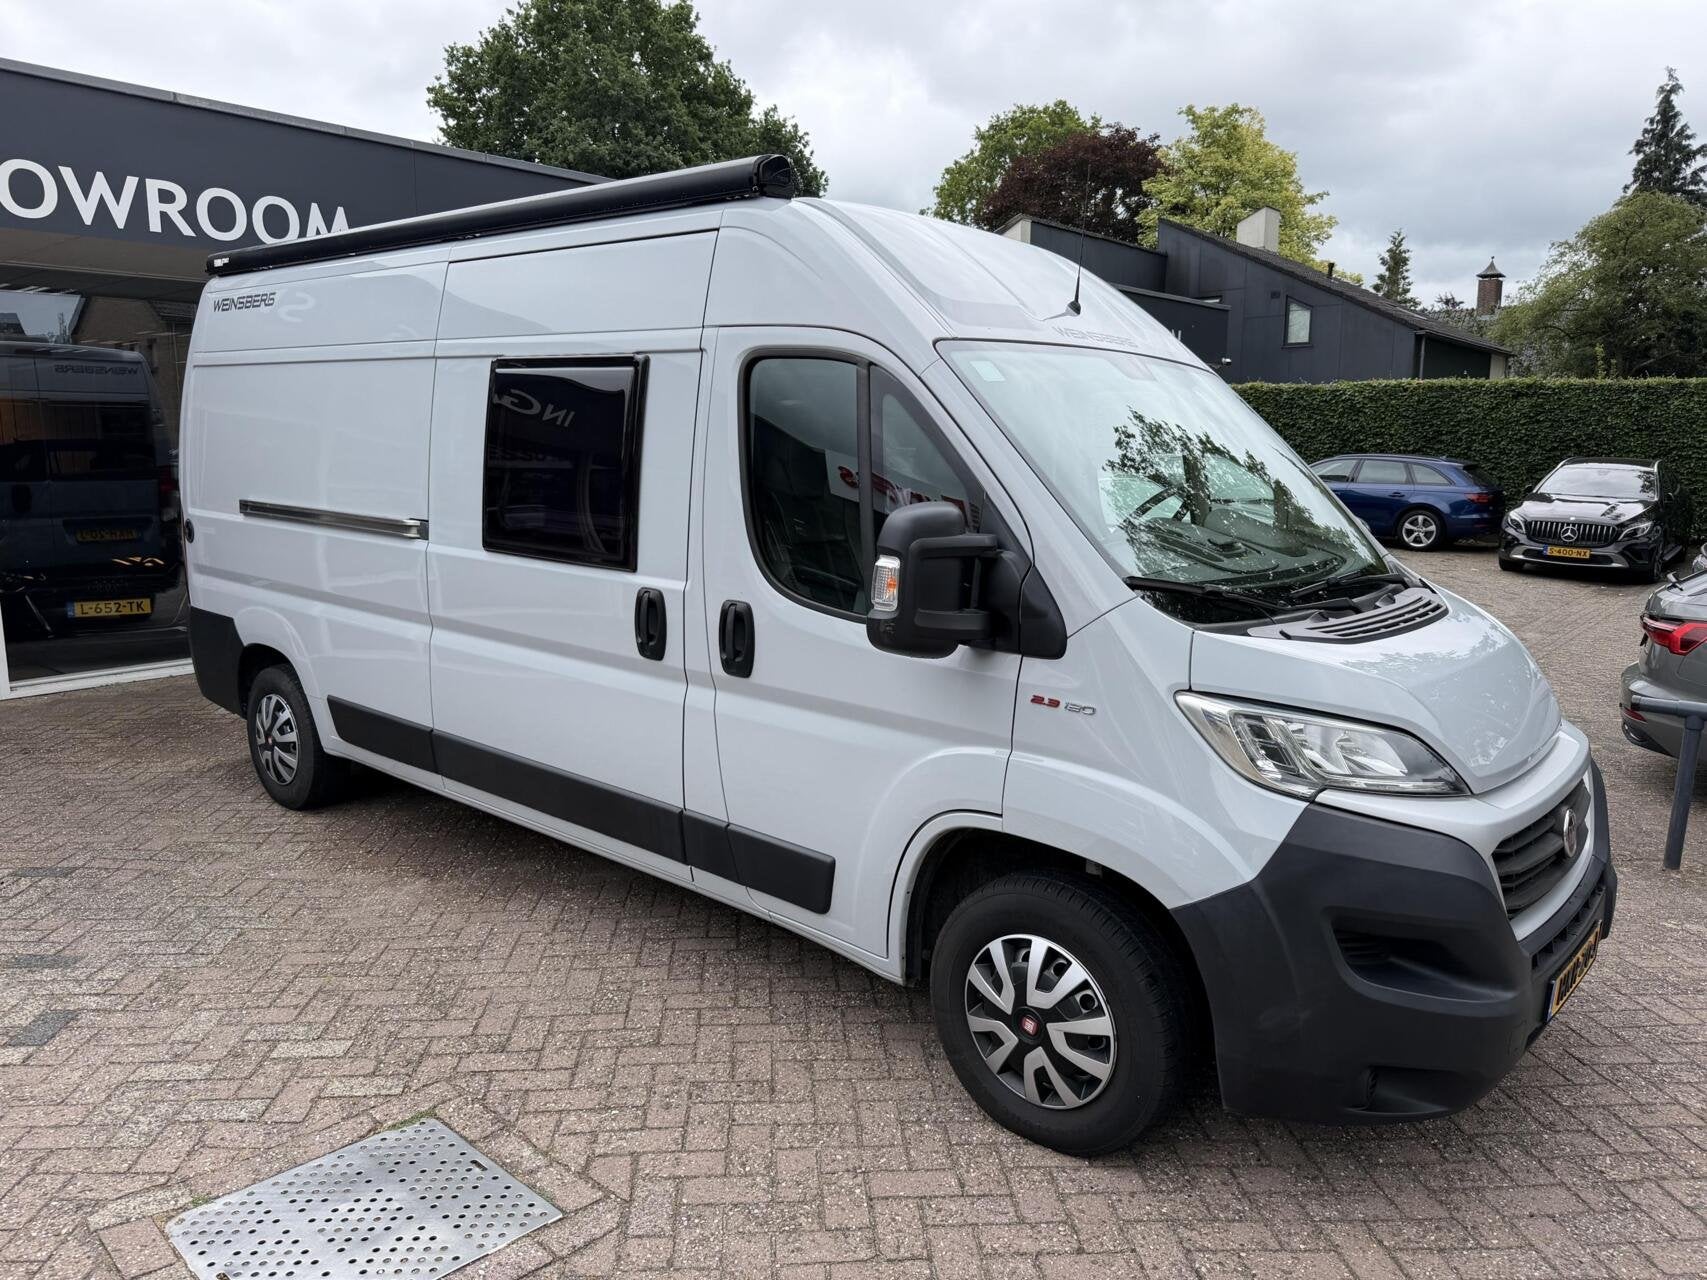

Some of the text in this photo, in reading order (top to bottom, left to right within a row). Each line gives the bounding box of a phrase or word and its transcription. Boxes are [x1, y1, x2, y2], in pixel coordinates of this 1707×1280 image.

[0, 158, 349, 245] OWROOM
[213, 292, 276, 312] WEINSBERG
[1549, 547, 1588, 557] S-400-NX
[80, 600, 146, 615] L-652-TK
[1030, 694, 1061, 709] 2.3
